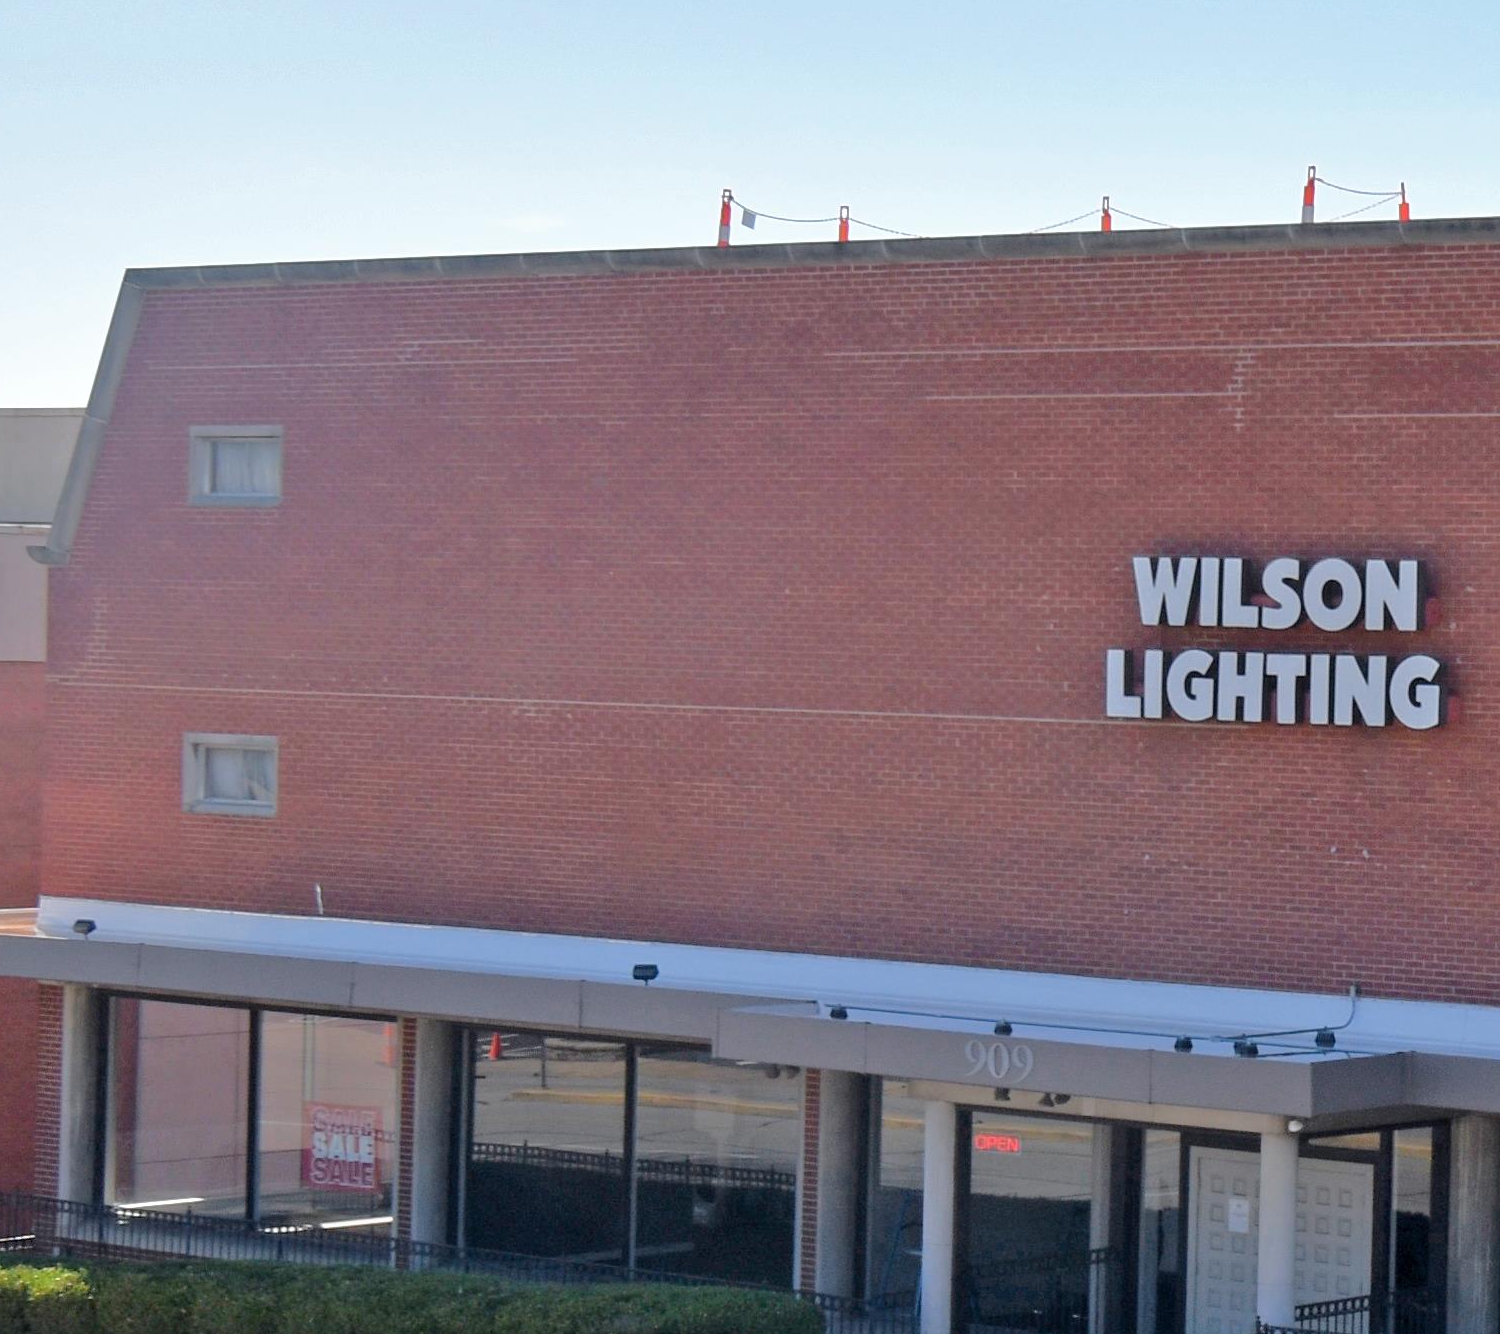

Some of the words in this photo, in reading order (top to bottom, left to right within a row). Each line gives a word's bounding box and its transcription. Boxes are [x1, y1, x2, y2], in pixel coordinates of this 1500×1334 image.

[1132, 556, 1419, 633] WILSON
[1105, 648, 1442, 731] LIGHTING
[963, 1039, 1035, 1085] 909
[311, 1106, 376, 1136] SALE
[311, 1130, 375, 1163] SALE
[975, 1133, 1020, 1153] OPEN
[309, 1156, 375, 1187] SALE
